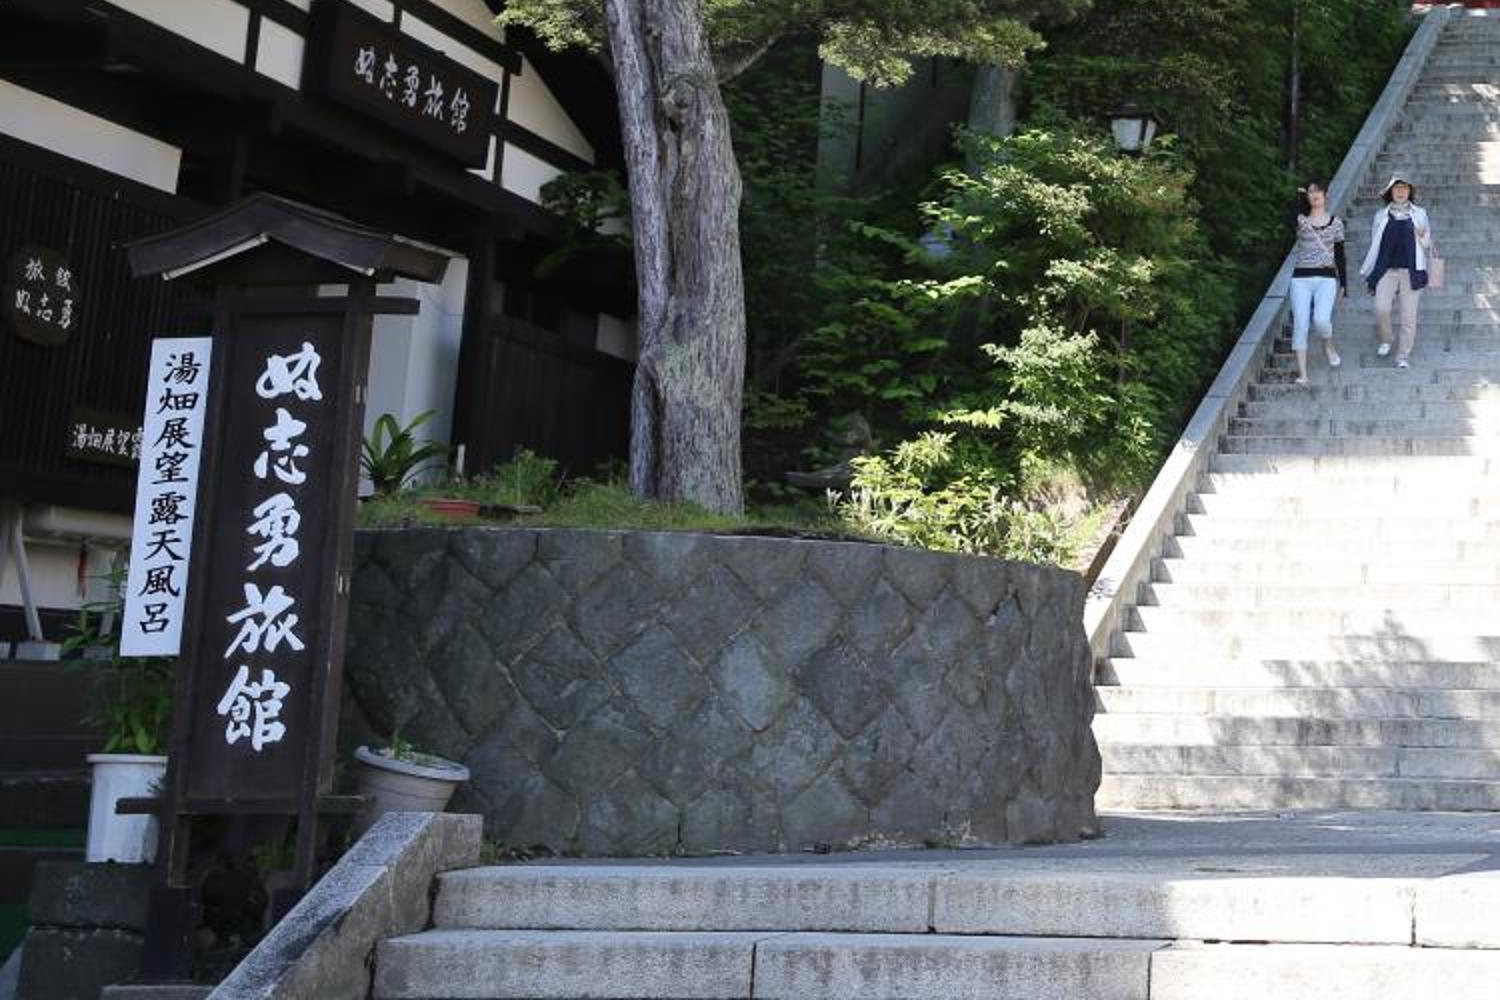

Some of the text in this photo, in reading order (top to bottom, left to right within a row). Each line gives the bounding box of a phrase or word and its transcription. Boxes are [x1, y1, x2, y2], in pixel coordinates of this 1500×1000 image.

[353, 45, 471, 135] ぬ志勇旅館
[138, 352, 200, 636] 湯畑展望露天風呂
[217, 341, 323, 752] ぬ志勇旅館
